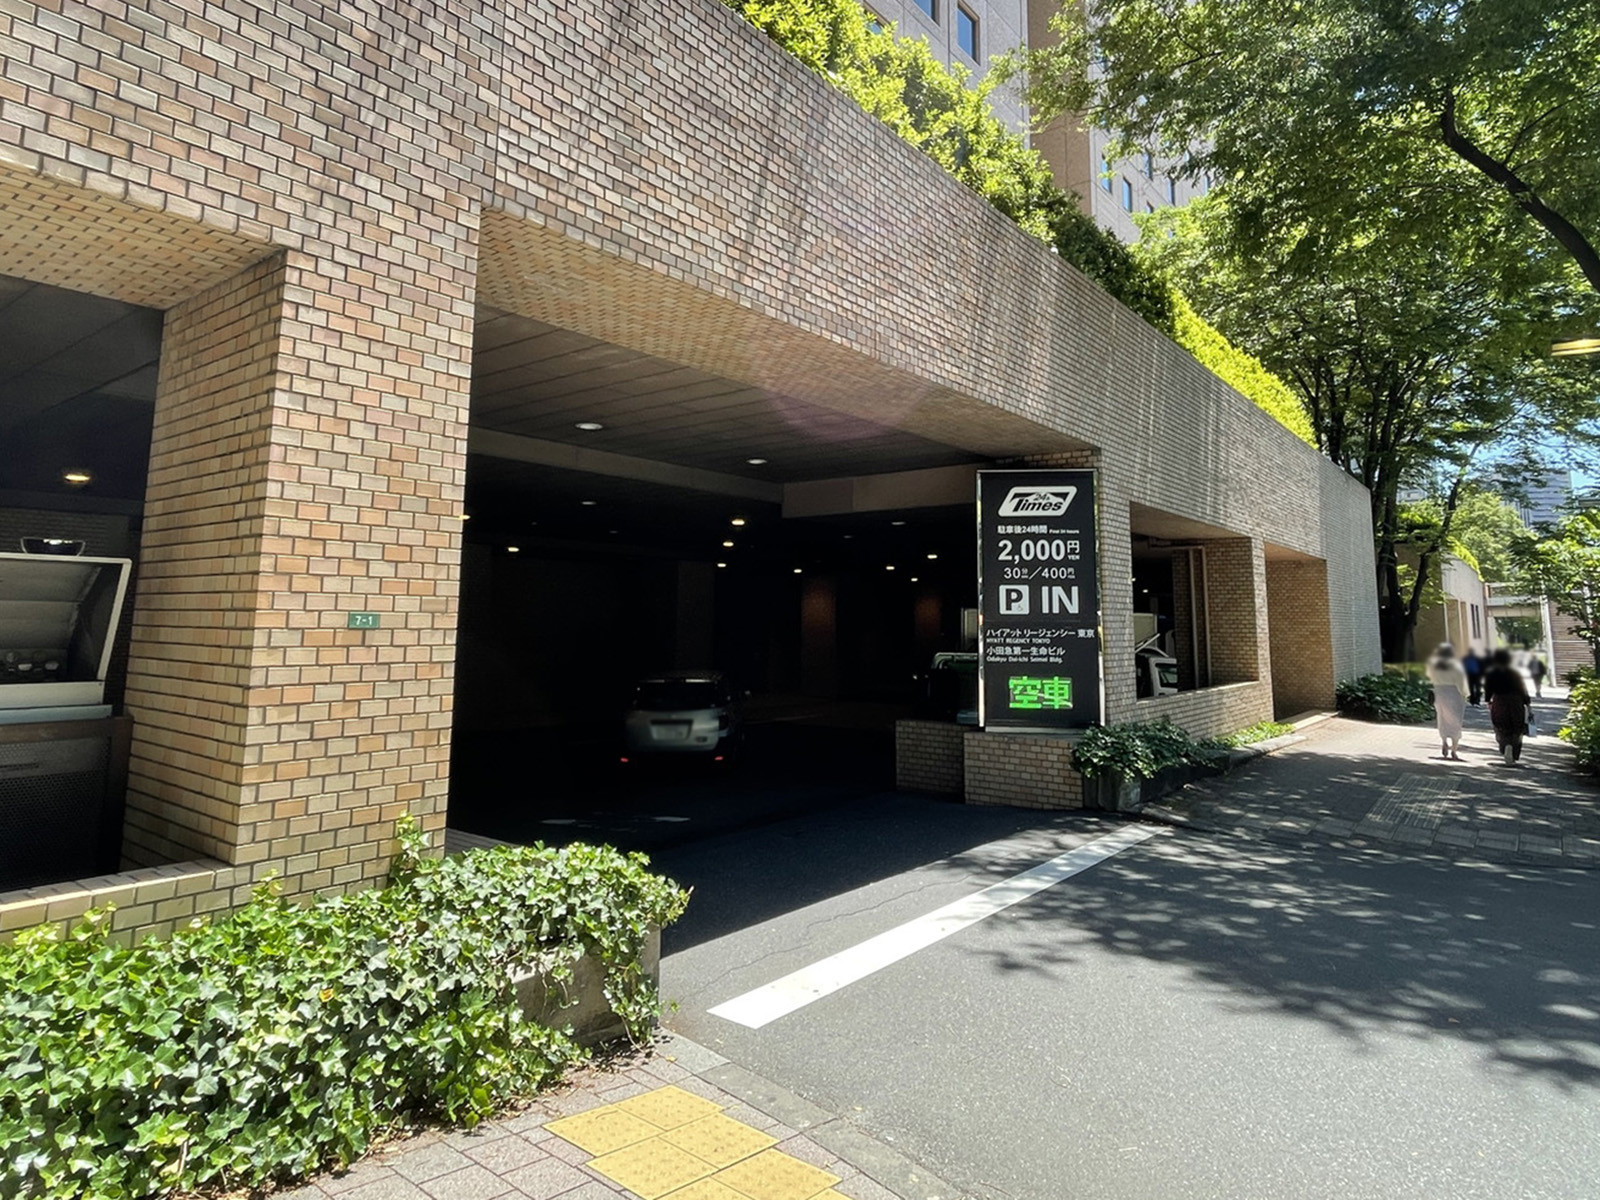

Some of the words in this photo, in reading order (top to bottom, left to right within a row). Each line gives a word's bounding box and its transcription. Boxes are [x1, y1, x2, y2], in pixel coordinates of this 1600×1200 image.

[1012, 498, 1064, 512] Times
[1041, 586, 1079, 614] IN
[355, 615, 373, 626] 7-1
[986, 646, 1066, 656] 小田急第一生命ビル
[1008, 676, 1073, 709] 空車
